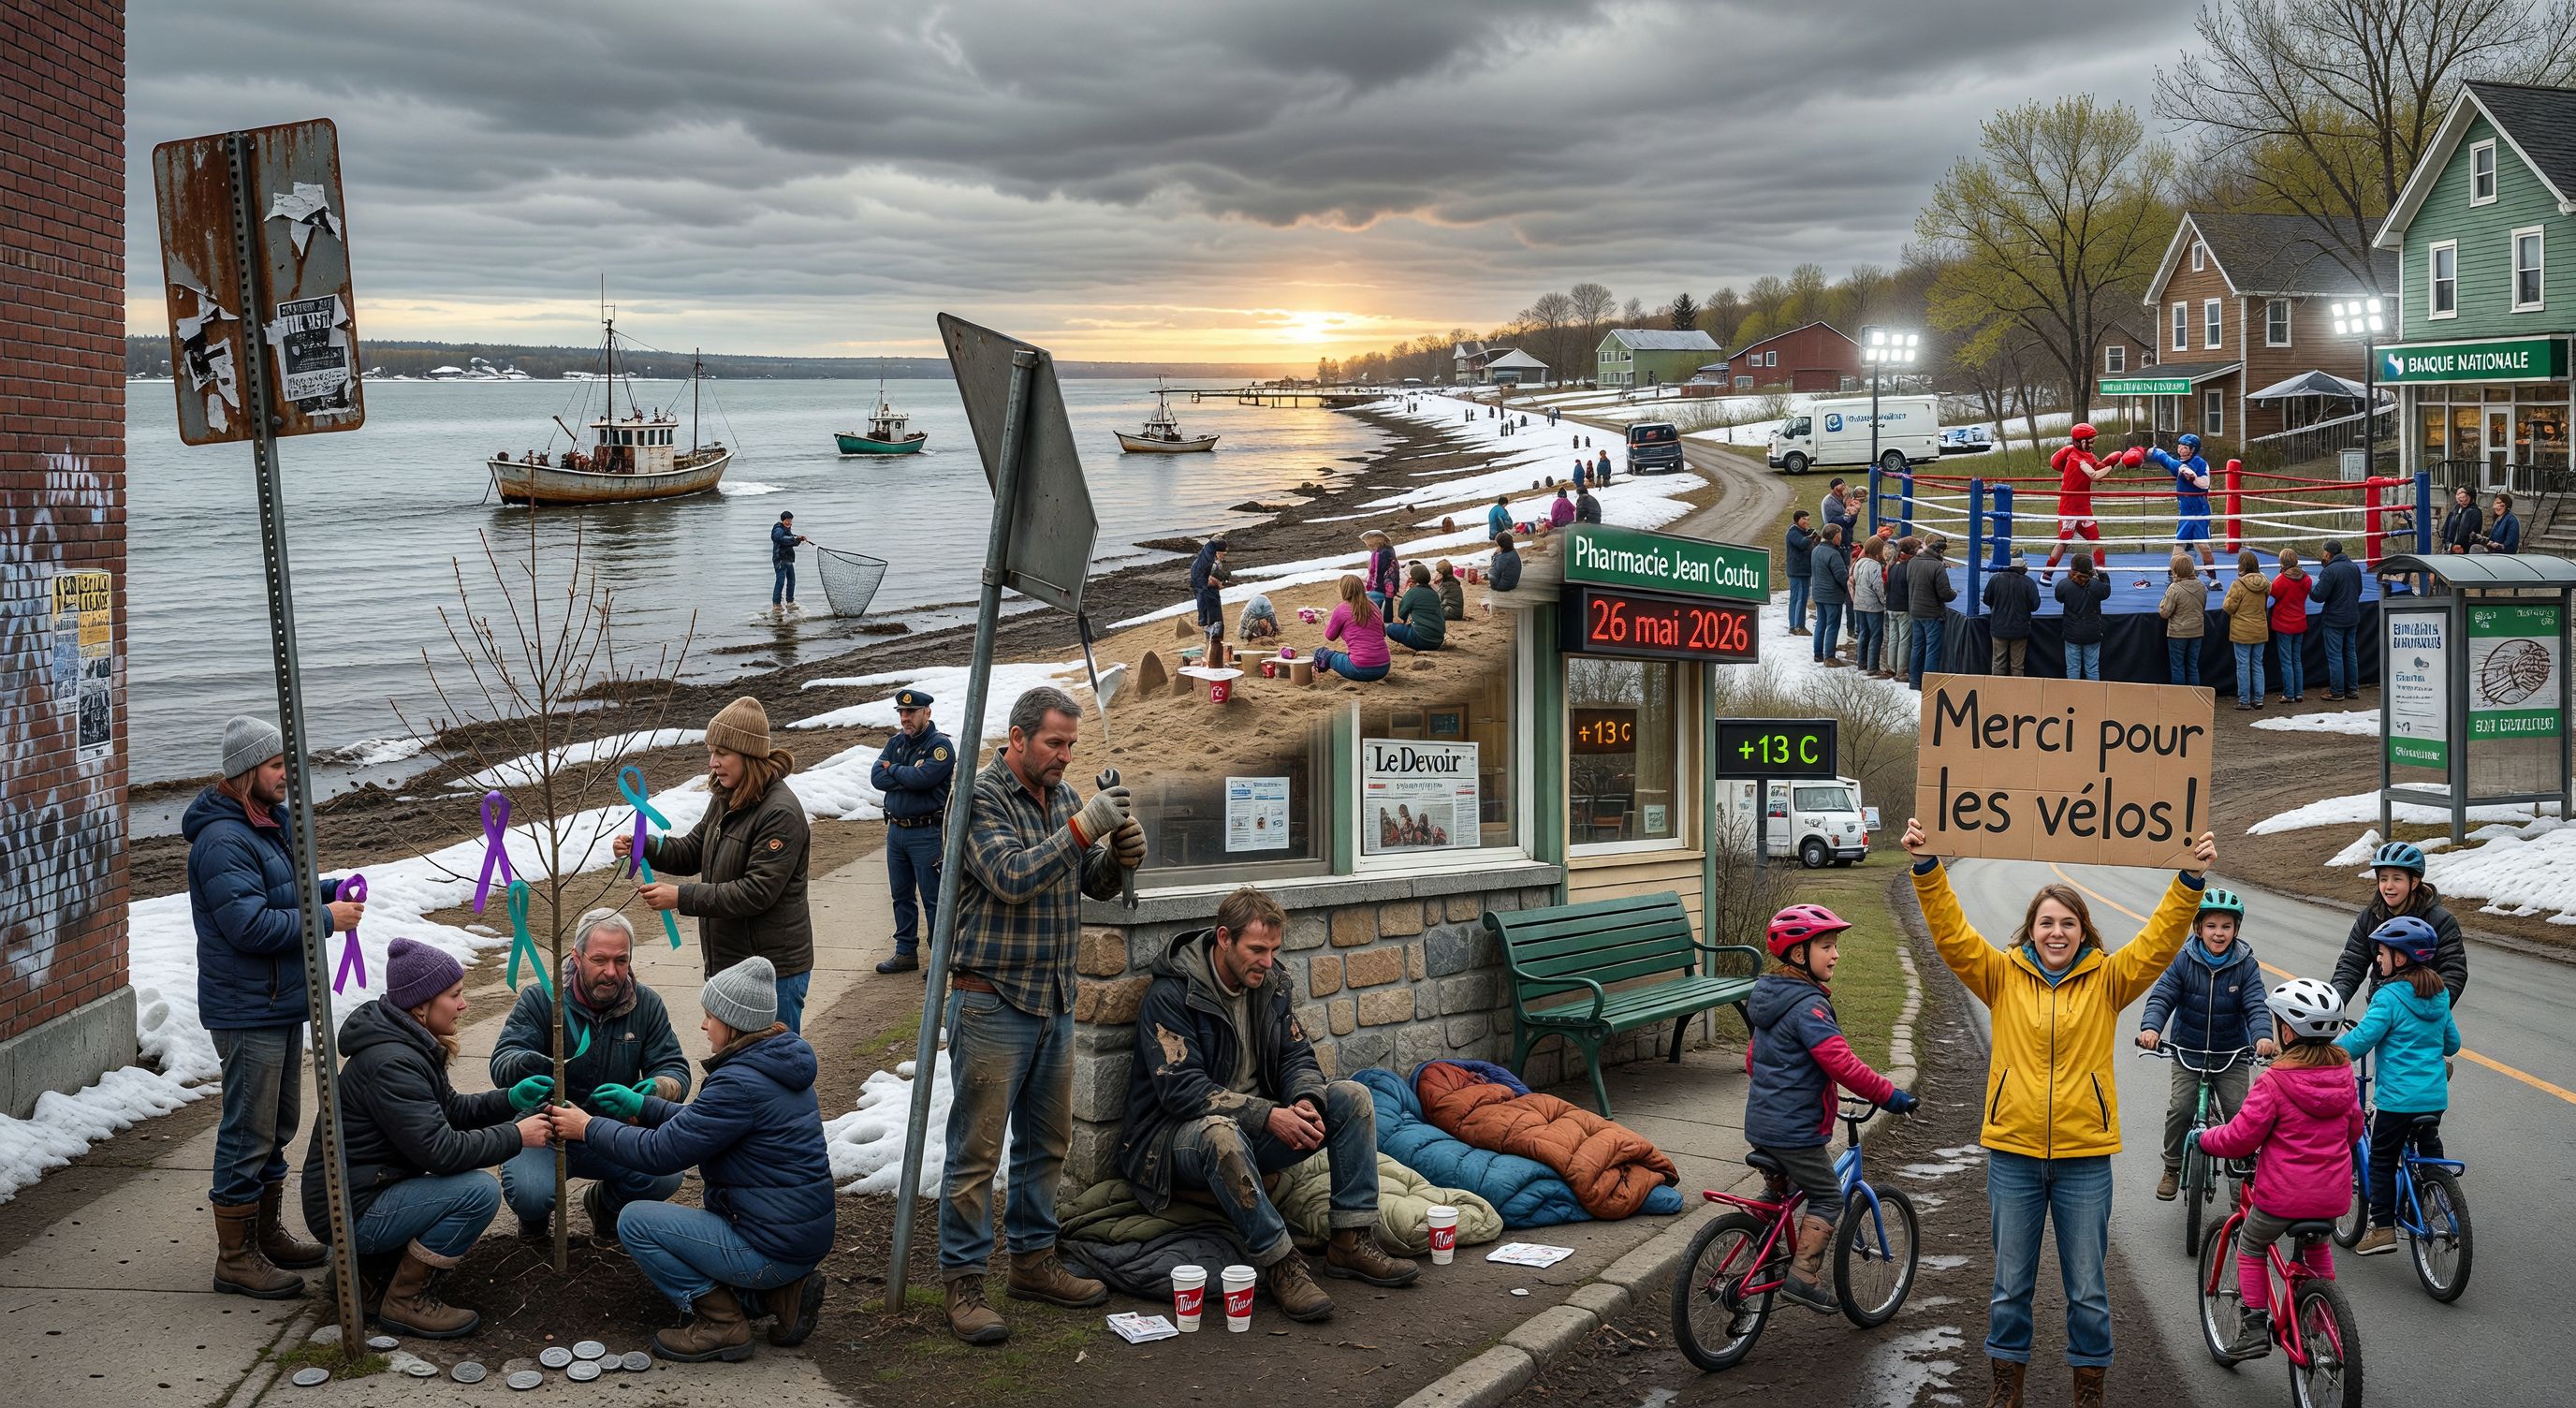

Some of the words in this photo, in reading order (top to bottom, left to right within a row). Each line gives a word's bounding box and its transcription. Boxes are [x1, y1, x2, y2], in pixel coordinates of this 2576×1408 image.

[2458, 351, 2528, 371] NATIONALE
[1575, 535, 1669, 577] Pharmacie
[1672, 550, 1709, 583] Jean
[1714, 556, 1759, 590] Coutu
[1591, 599, 1627, 642] 26
[1635, 609, 1679, 646] mai
[1688, 609, 1749, 651] 2026
[1578, 721, 1617, 744] +13
[1621, 723, 1631, 741] C
[1738, 734, 1790, 764] +13
[1799, 735, 1819, 764] C
[1933, 688, 2074, 752] Merci
[2100, 720, 2204, 773] pour
[1939, 766, 2011, 833] les
[2036, 777, 2198, 847] vélos!
